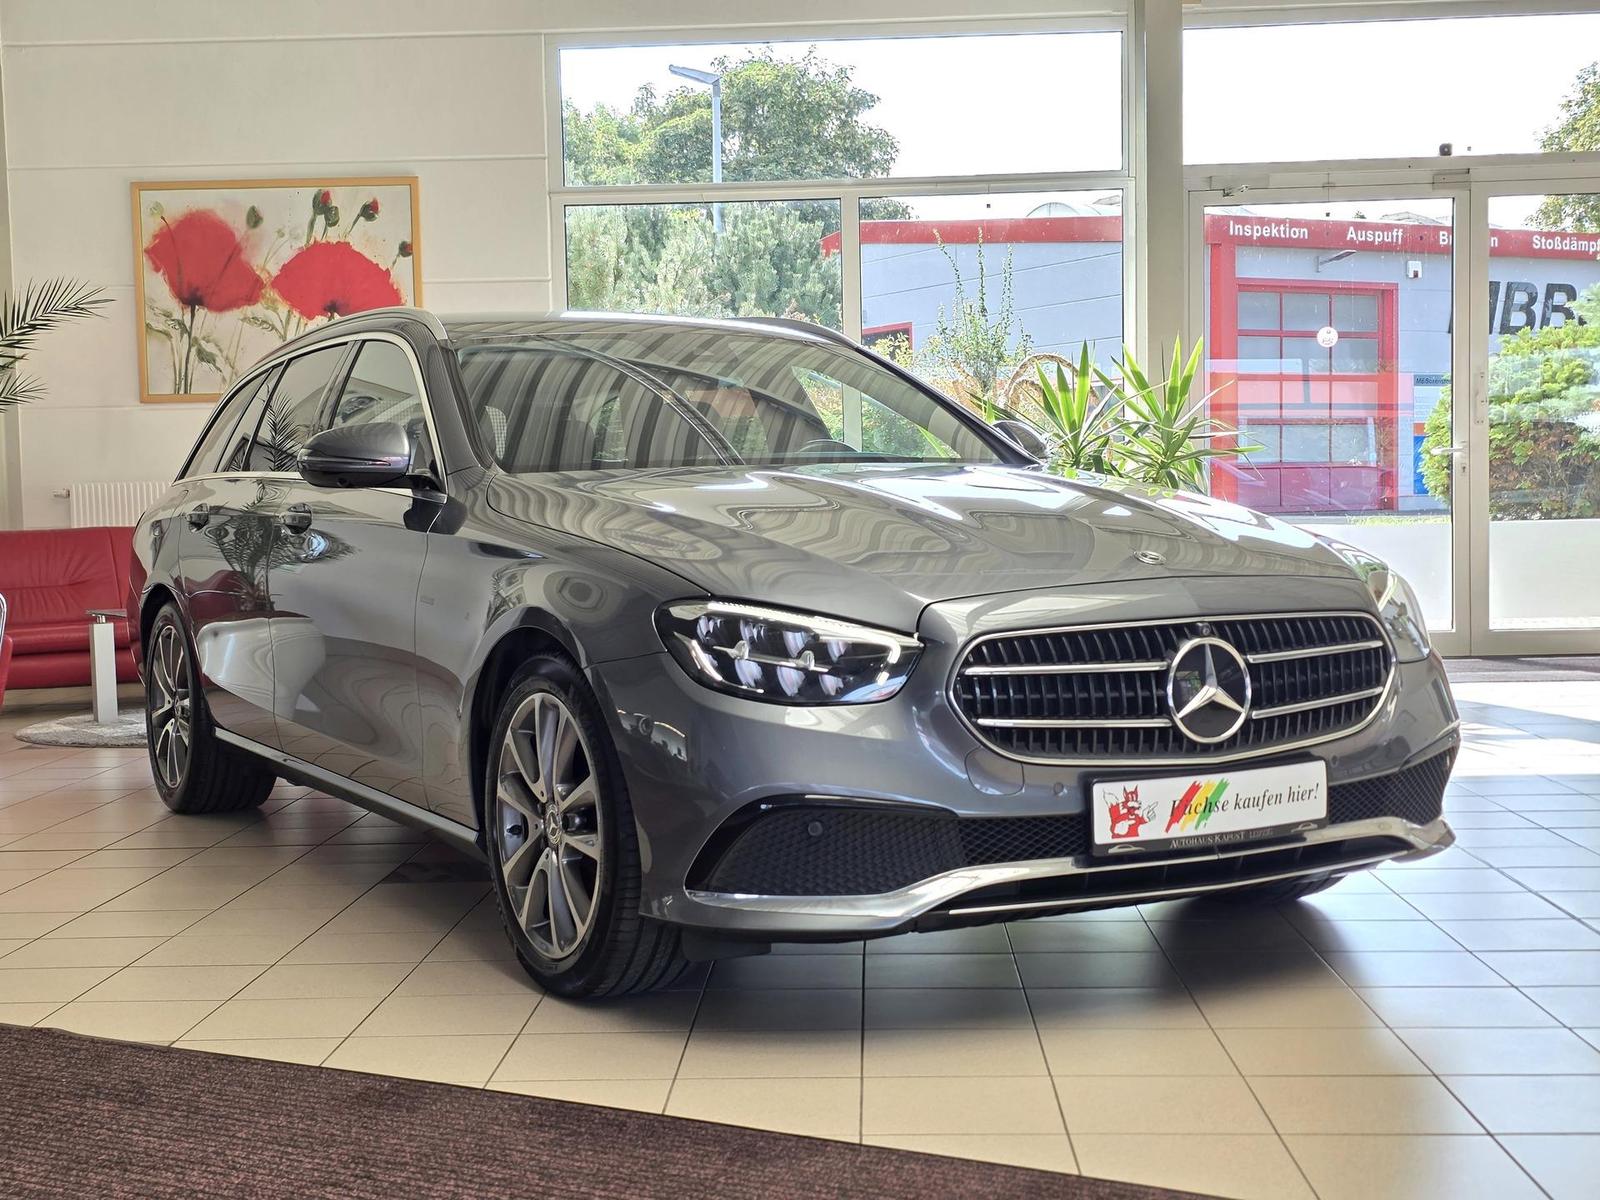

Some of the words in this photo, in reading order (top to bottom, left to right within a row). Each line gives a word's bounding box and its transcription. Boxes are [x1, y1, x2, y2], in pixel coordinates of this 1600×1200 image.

[1229, 220, 1309, 240] Inspektion
[1346, 226, 1403, 245] Auspuff
[1233, 789, 1283, 812] kaufen
[1287, 783, 1320, 803] hier!
